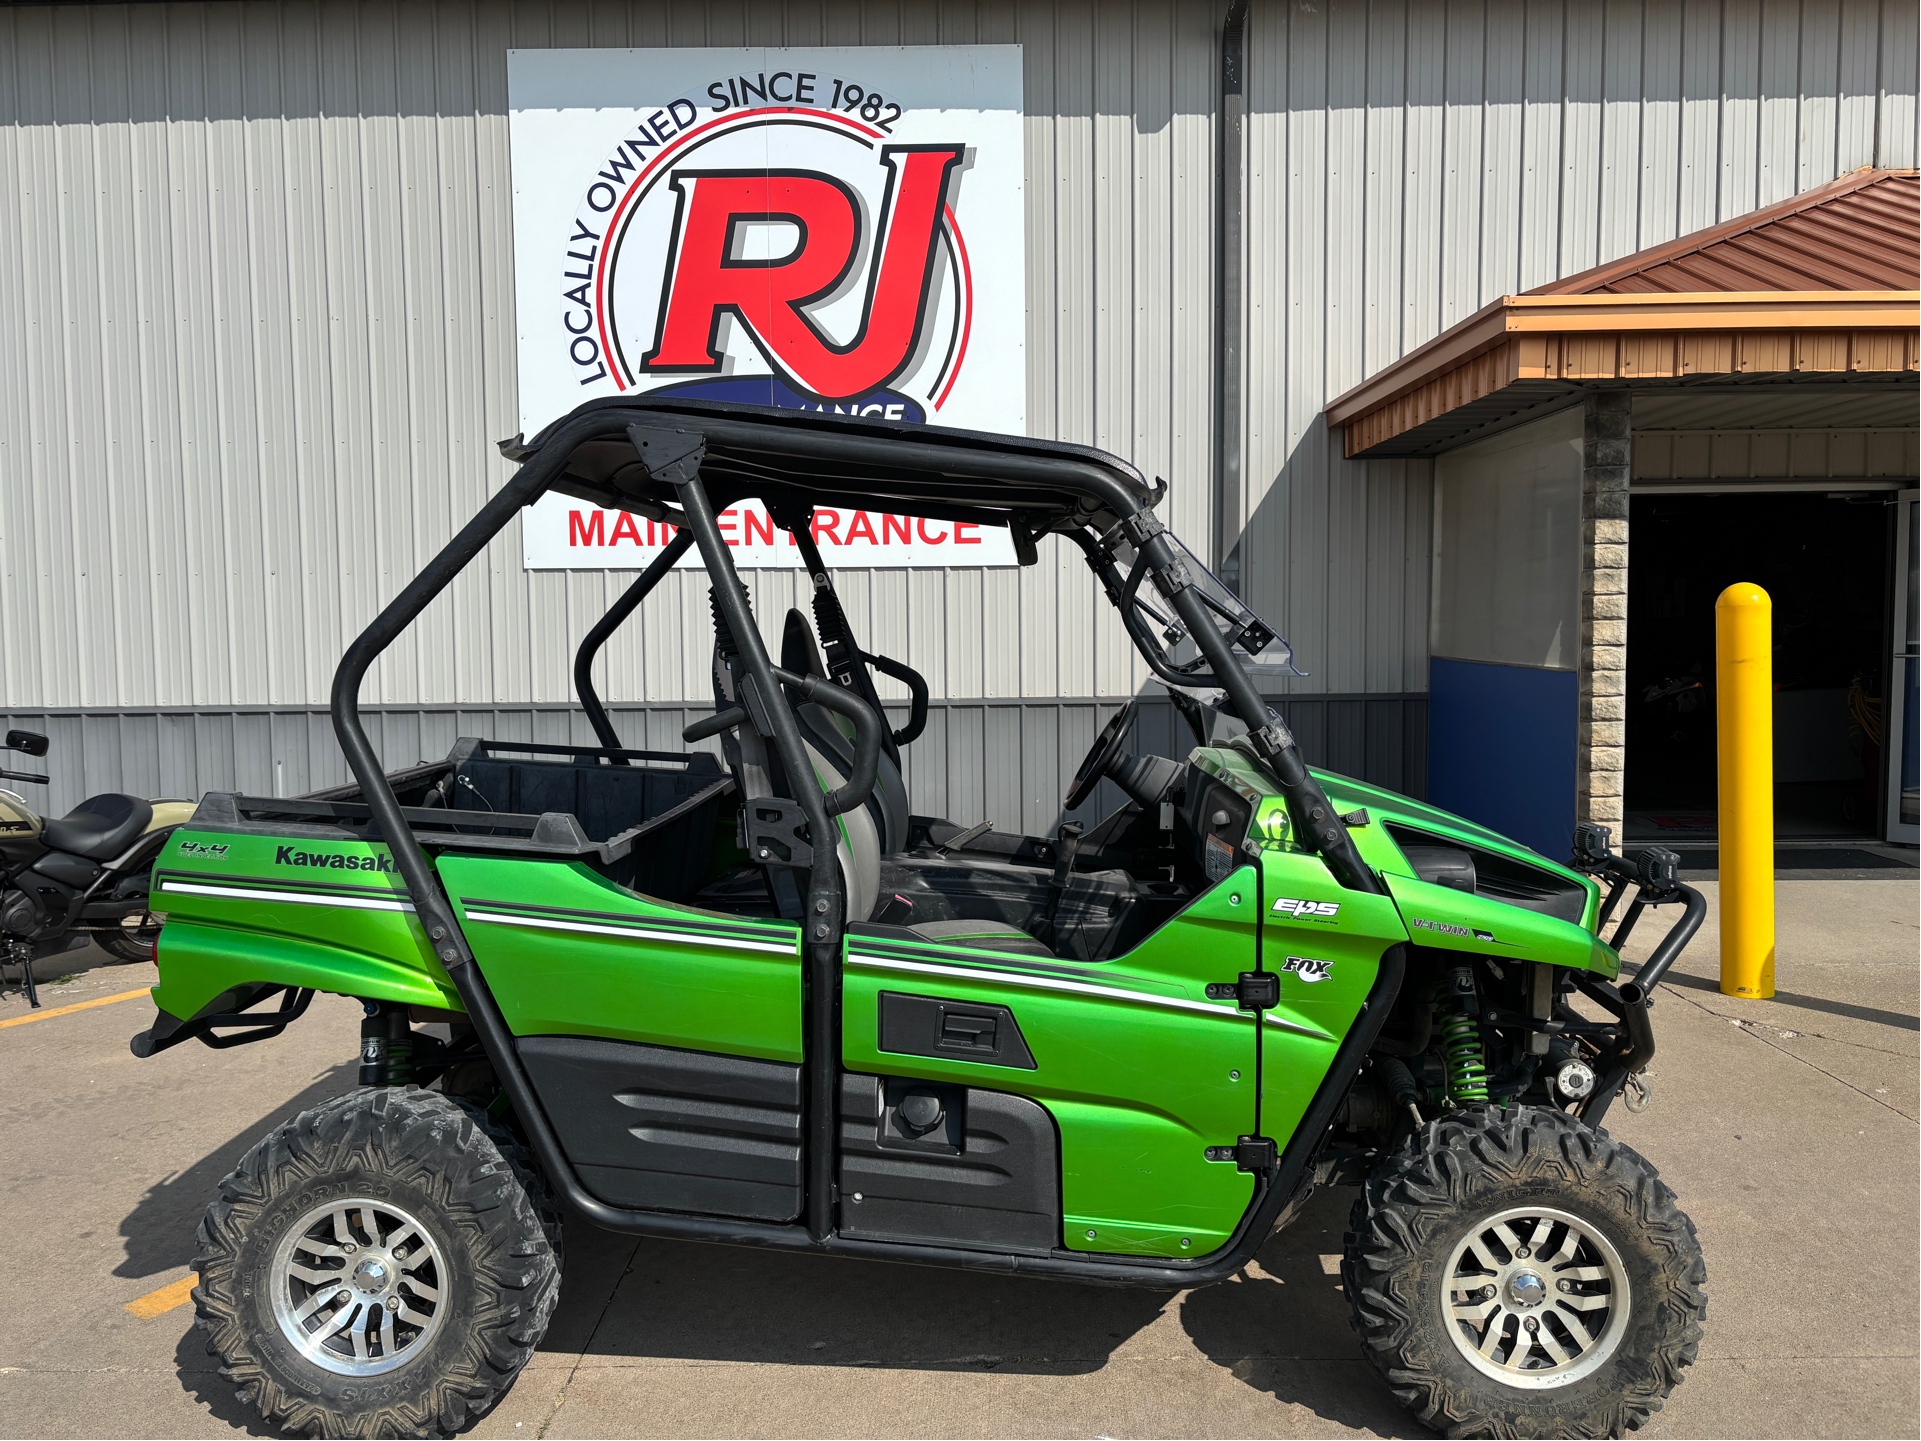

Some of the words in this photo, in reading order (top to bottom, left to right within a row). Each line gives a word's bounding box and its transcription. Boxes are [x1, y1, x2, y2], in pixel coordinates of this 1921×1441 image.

[563, 218, 607, 386] LOCALLY
[587, 98, 697, 212] OWNED
[707, 72, 816, 112] SINCE
[831, 79, 901, 134] 1982
[638, 142, 966, 404] RJ
[180, 841, 230, 854] 4x4
[1412, 917, 1470, 938] V-TWIN
[1280, 955, 1335, 975] FOX
[254, 1182, 348, 1252] BIGHORN
